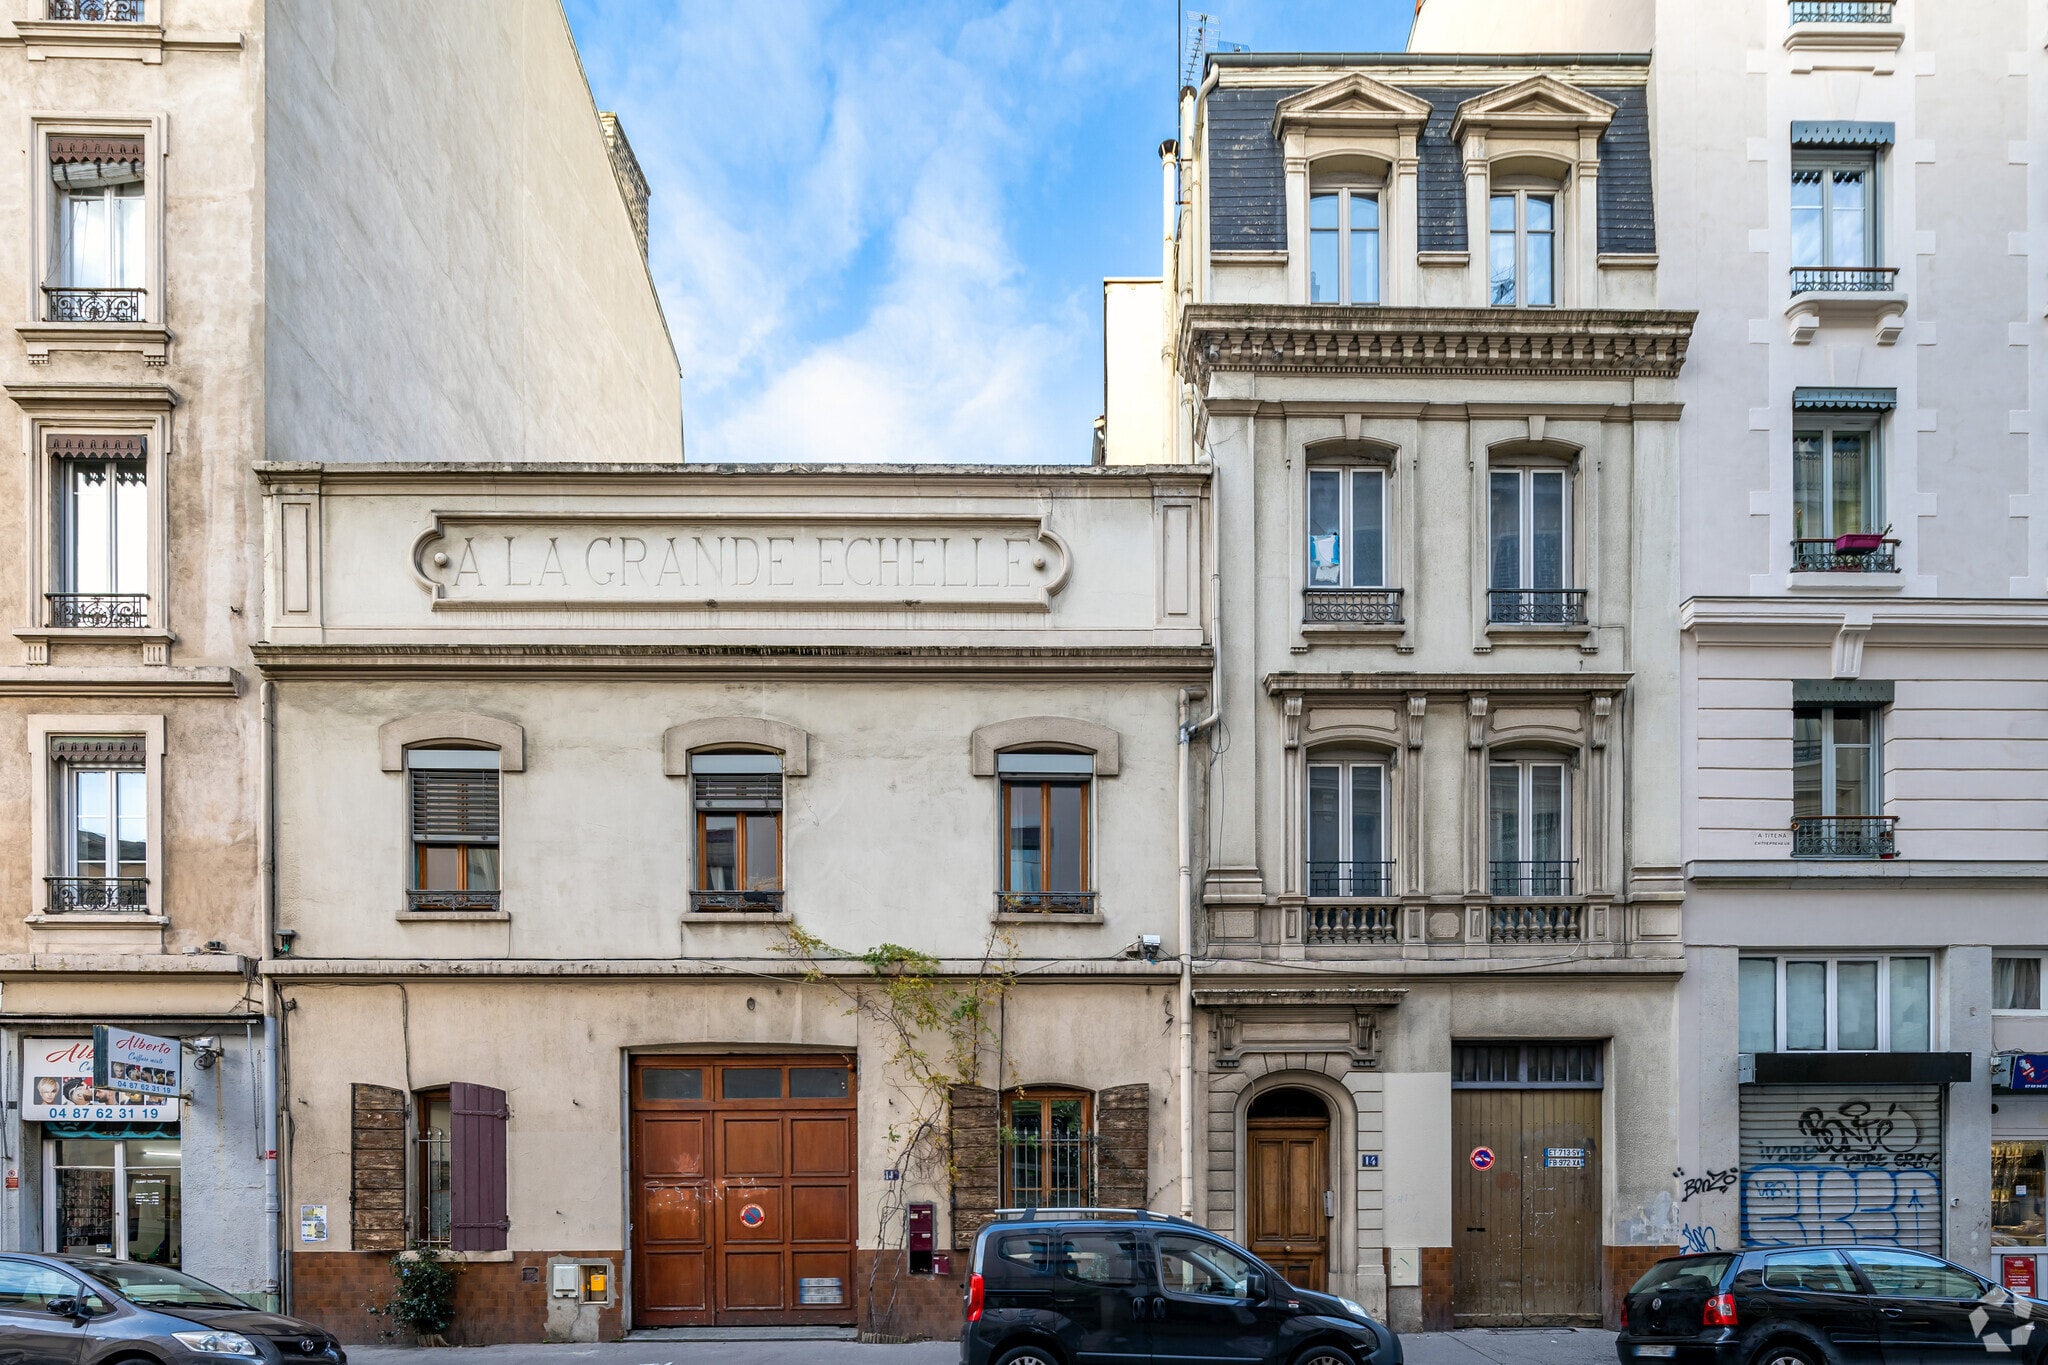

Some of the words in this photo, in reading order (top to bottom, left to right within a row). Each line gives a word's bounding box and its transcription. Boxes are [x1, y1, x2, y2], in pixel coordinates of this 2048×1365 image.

[451, 536, 486, 587] A
[503, 536, 571, 587] LA
[585, 536, 795, 587] GRANDE
[816, 537, 1031, 588] ECHELLE
[116, 1035, 172, 1054] Alberto
[117, 1080, 127, 1088] 04
[49, 1107, 67, 1119] 04
[72, 1107, 90, 1119] 87
[96, 1108, 113, 1119] 62
[118, 1108, 134, 1119] 31
[142, 1108, 159, 1119] 19
[1365, 1156, 1377, 1166] 14
